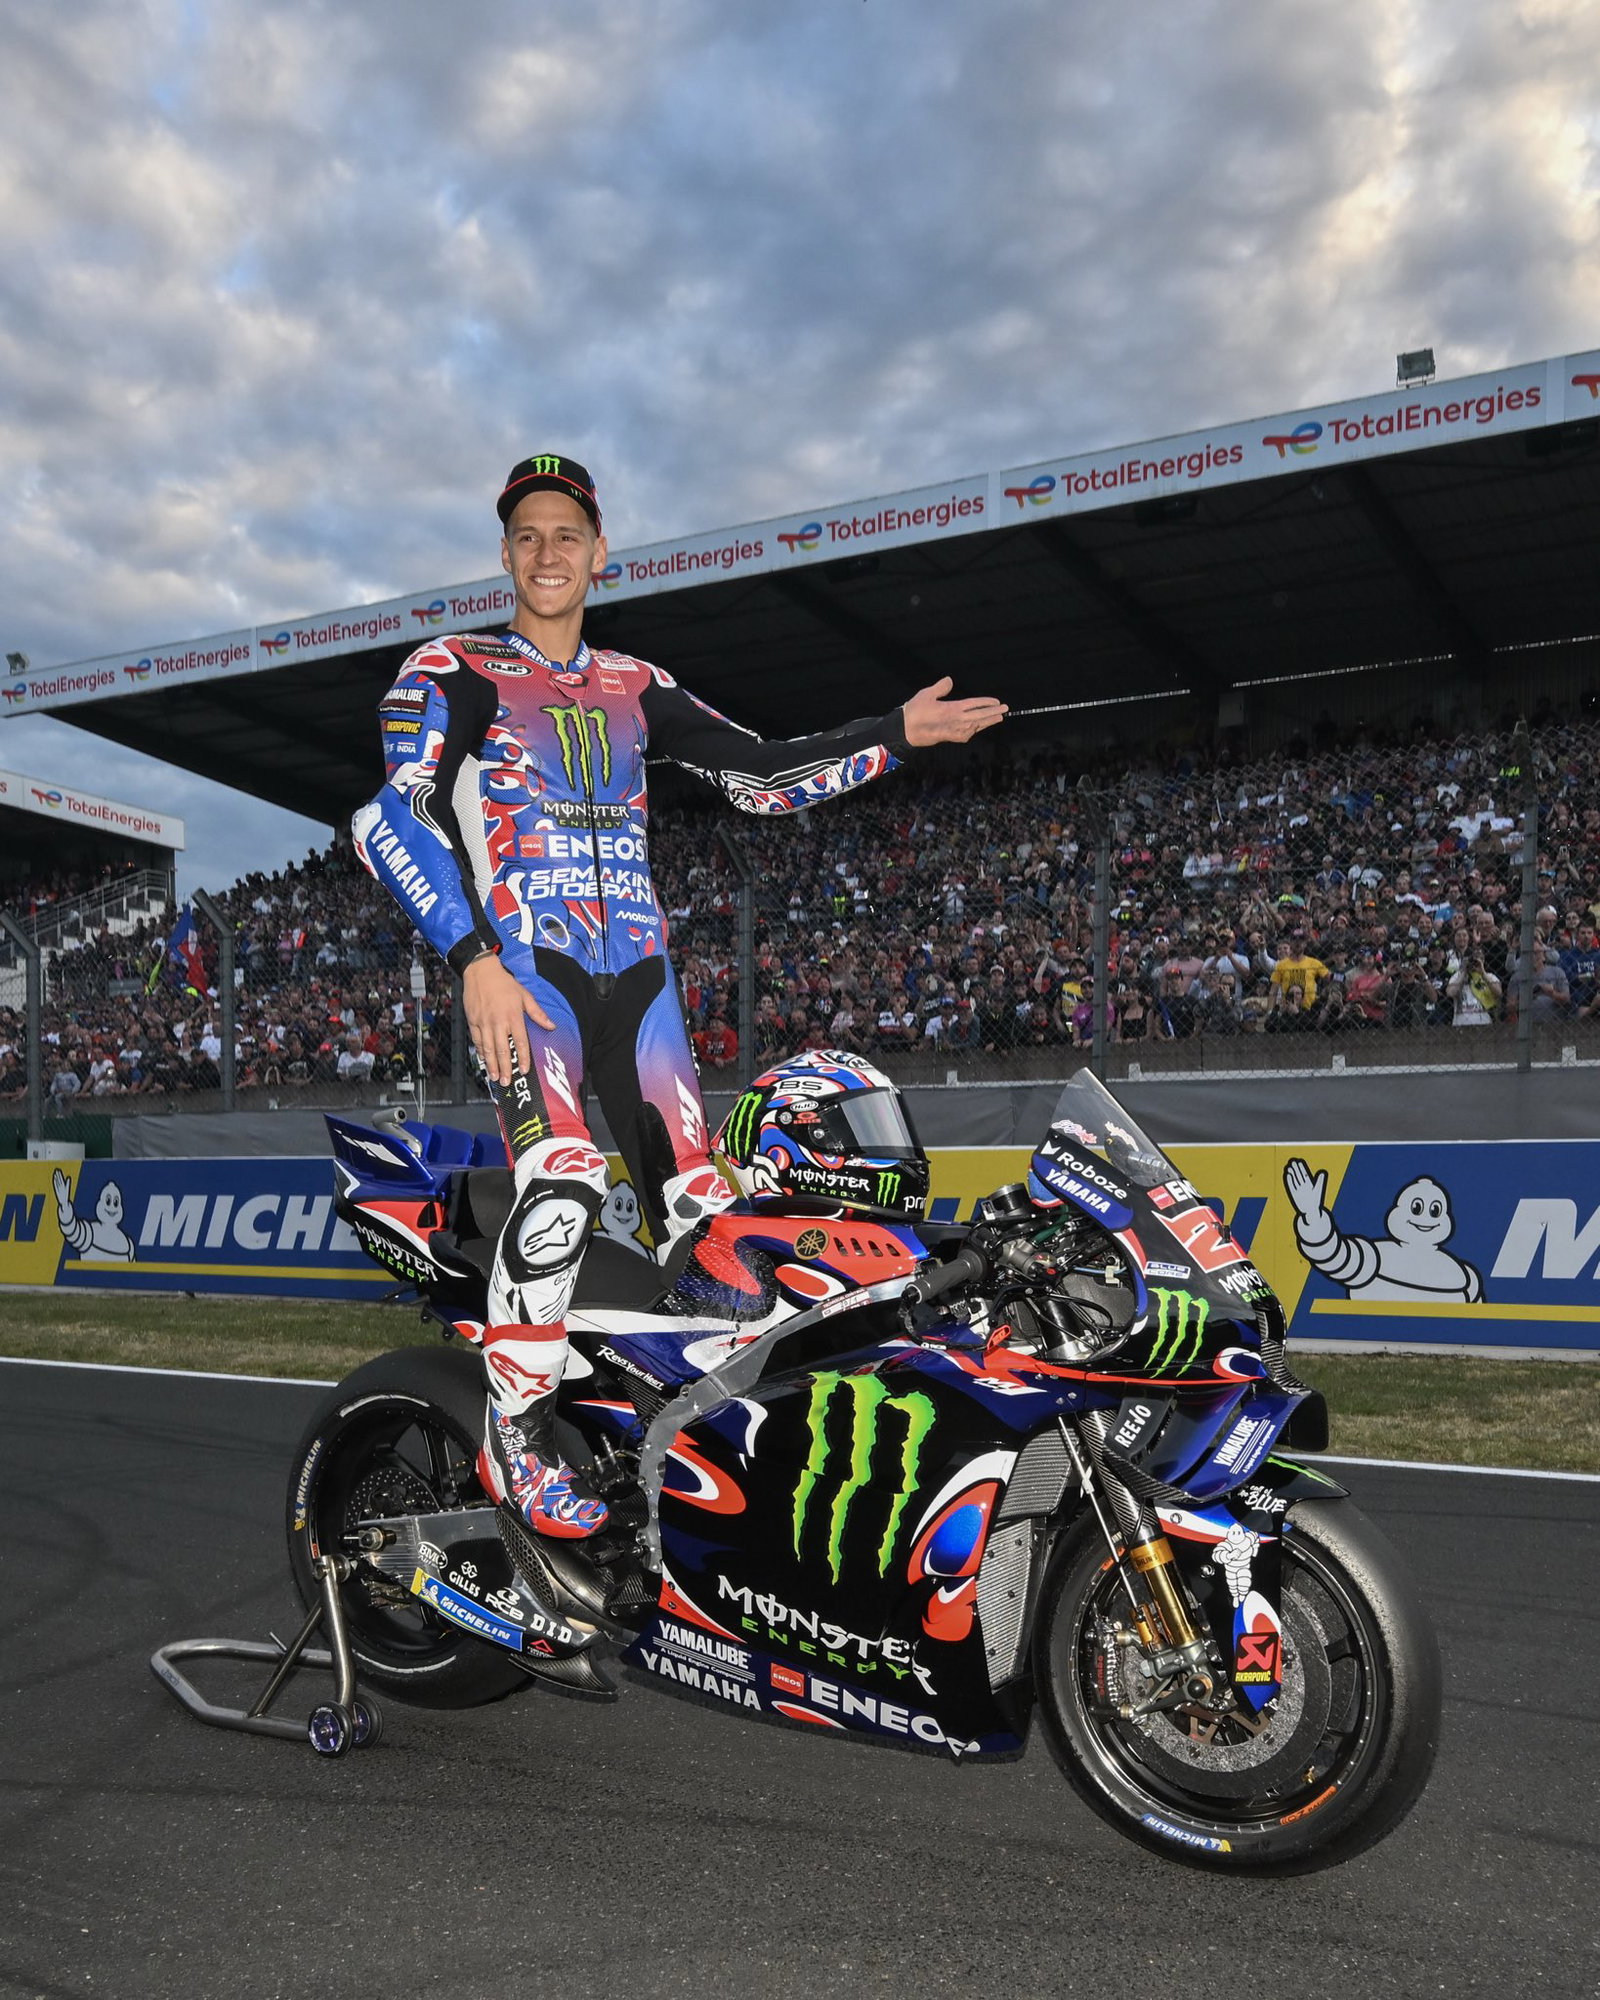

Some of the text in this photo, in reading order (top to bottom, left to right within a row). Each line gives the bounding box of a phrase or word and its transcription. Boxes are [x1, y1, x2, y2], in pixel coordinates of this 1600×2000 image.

[1328, 385, 1541, 444] TotalEnergies
[1061, 443, 1243, 496] TotalEnergies
[826, 495, 985, 542] TotalEnergies
[626, 540, 764, 582] TotalEnergies
[448, 590, 515, 617] TotalEn
[293, 613, 400, 649] TotalEnergies
[153, 643, 250, 674] TotalEnergies
[29, 668, 115, 699] TotalEnergies
[65, 797, 162, 834] TotalEnergies
[543, 802, 630, 818] MONSTER
[547, 835, 645, 861] ENEOS
[371, 820, 439, 918] YAMAHA
[562, 882, 652, 904] DEPAN
[779, 1081, 823, 1091] BS
[789, 1168, 871, 1192] MONSTER
[800, 1185, 858, 1198] ENERGY
[1045, 1169, 1111, 1214] YAMAHA
[1057, 1152, 1128, 1199] Roboze
[355, 1220, 438, 1281] MONSTER
[368, 1243, 424, 1282] ENERGY
[596, 1344, 665, 1388] Revs Your Heart
[1213, 1415, 1259, 1467] YAMALUBE
[296, 1439, 321, 1505] MICHELIN
[1245, 1491, 1287, 1514] BLUE
[418, 1544, 445, 1565] BMC
[450, 1571, 481, 1597] GILLES
[440, 1596, 511, 1640] MICHELIN
[485, 1593, 524, 1620] RCB
[530, 1613, 573, 1643] D.I.D
[659, 1620, 749, 1670] YAMALUBE
[718, 1575, 938, 1695] MONSTER
[742, 1616, 910, 1680] ENERGY
[640, 1648, 761, 1711] YAMAHA
[667, 1649, 687, 1661] Liquid
[687, 1656, 710, 1670] Engine
[711, 1666, 749, 1684] Component
[773, 1673, 801, 1688] ENEOS
[1147, 1816, 1208, 1847] MICHELIN
